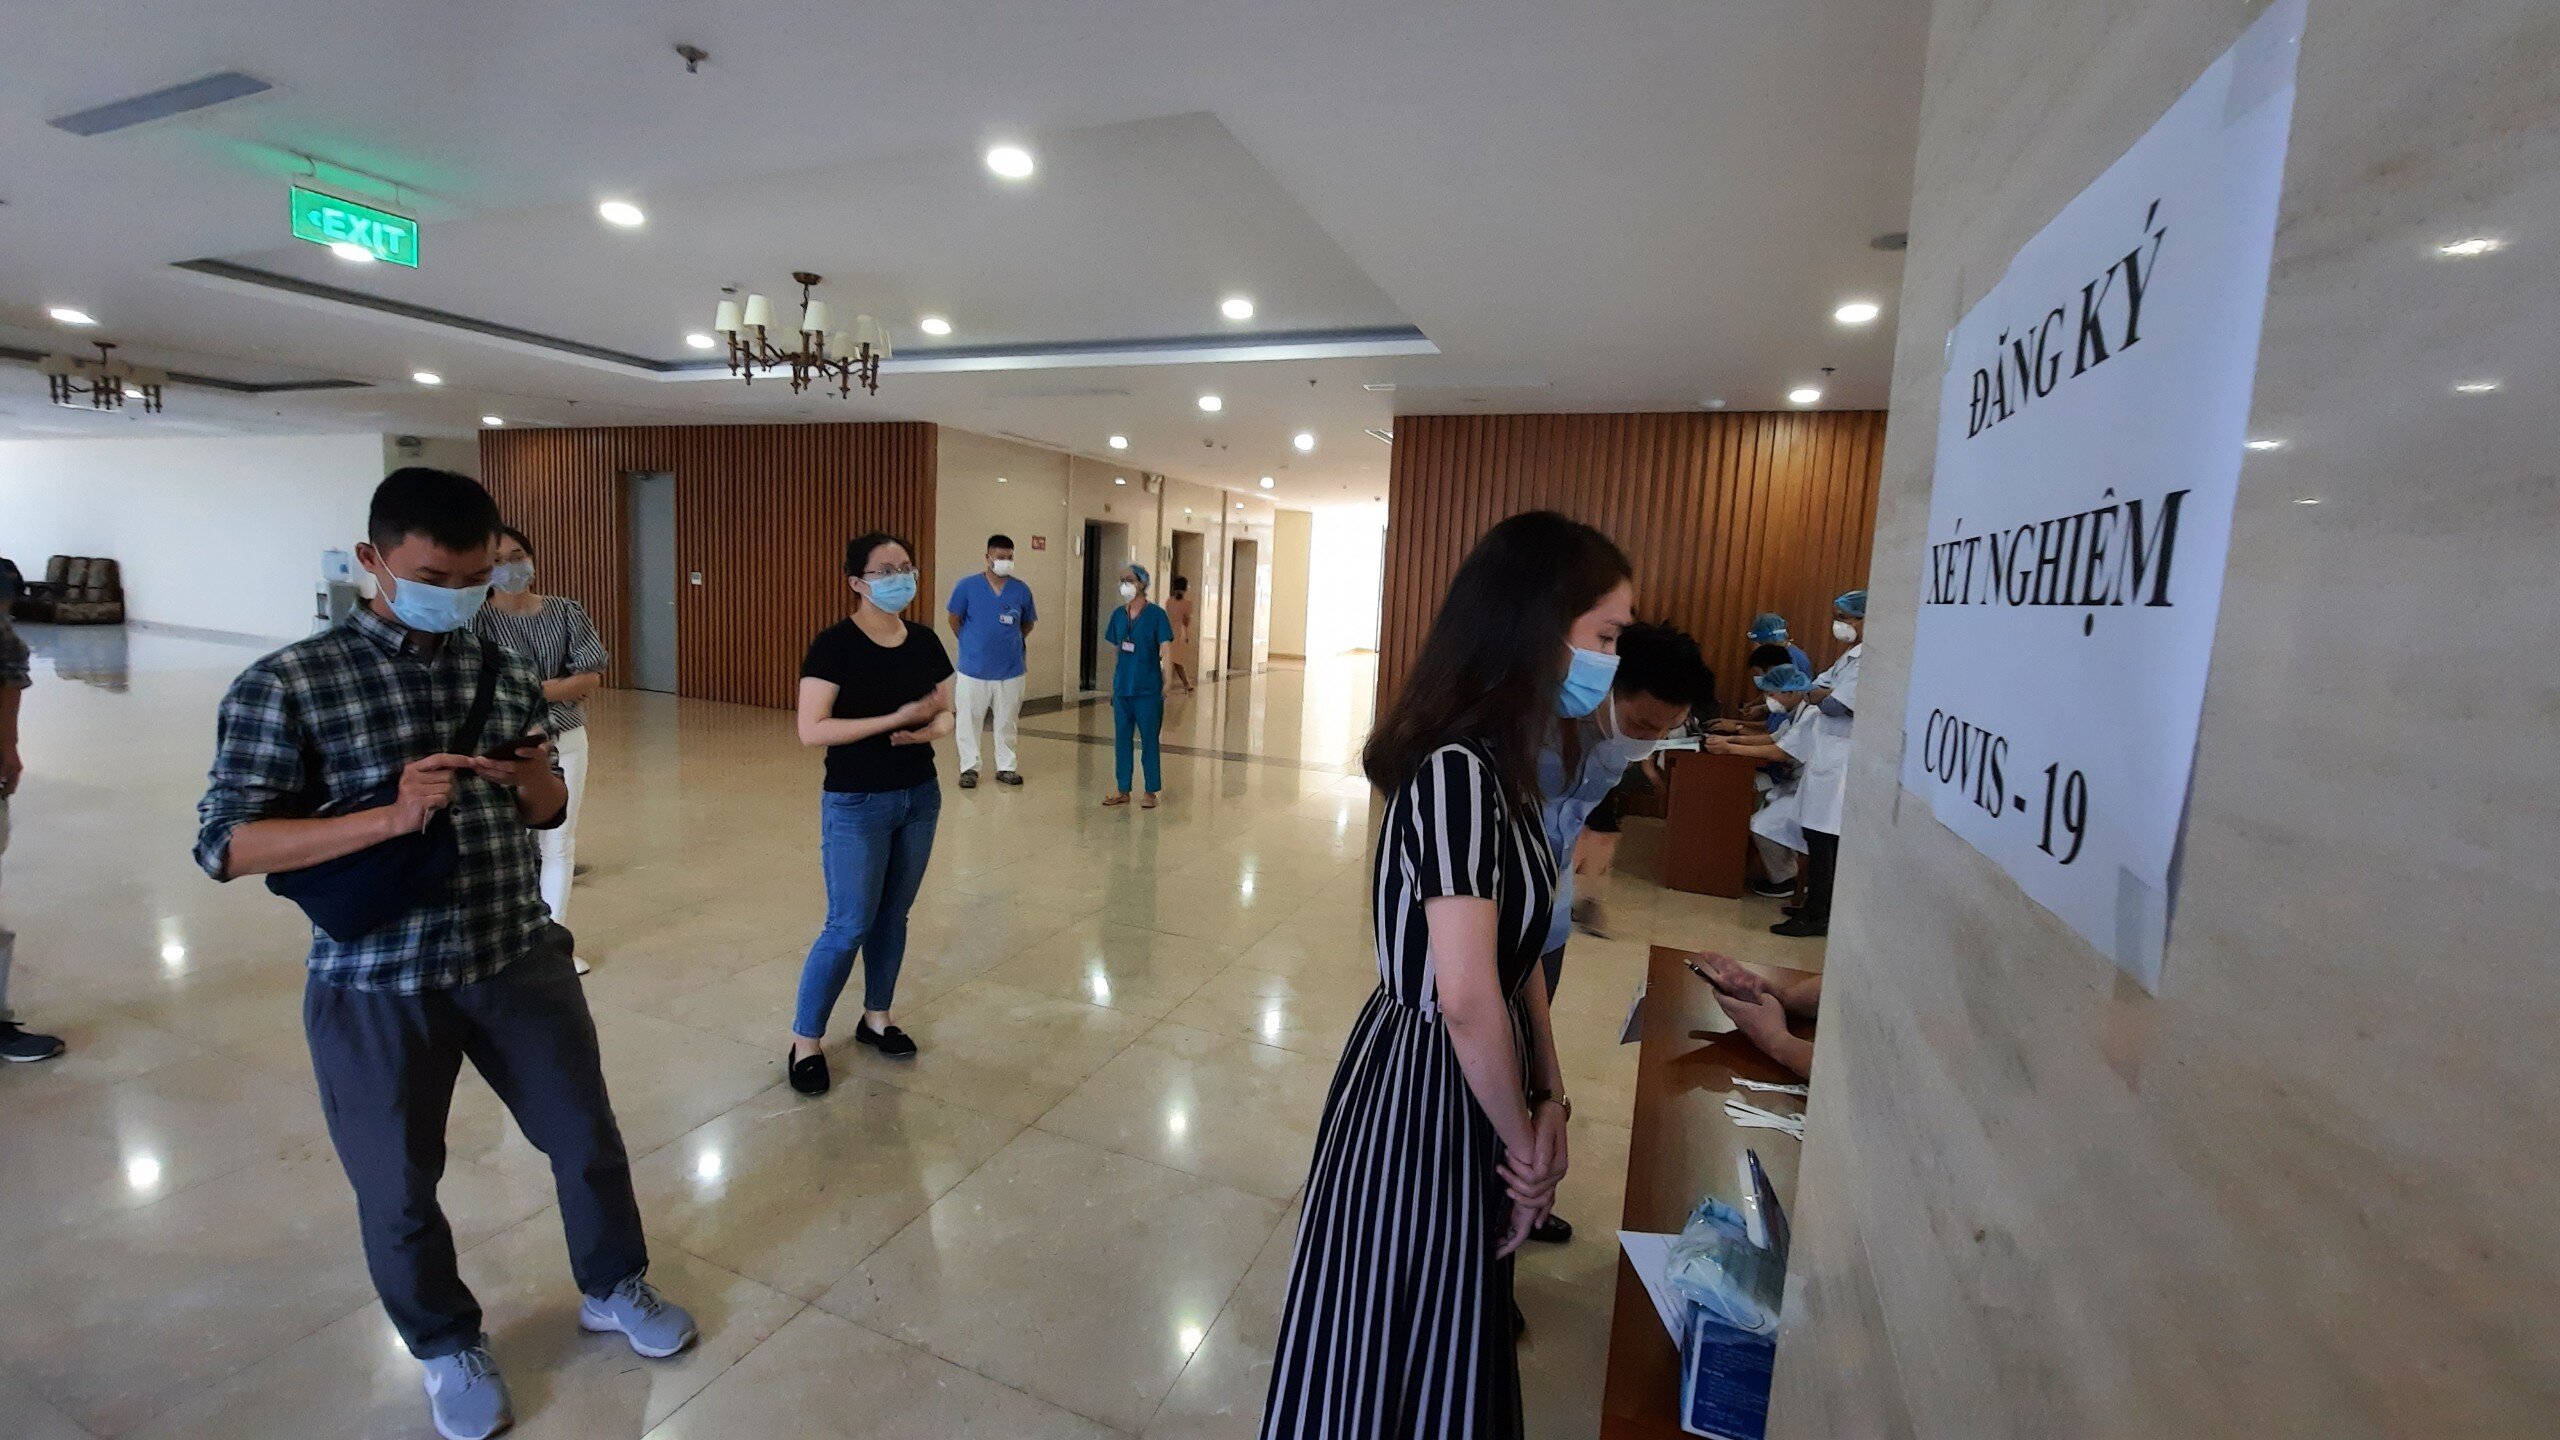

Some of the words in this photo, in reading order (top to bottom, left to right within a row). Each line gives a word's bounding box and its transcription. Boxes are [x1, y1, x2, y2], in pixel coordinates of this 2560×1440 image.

[322, 207, 407, 254] EXIT
[1967, 303, 2065, 439] ĐĂNG
[2071, 198, 2167, 379] KÝ
[1926, 517, 1981, 605] XÉT
[1980, 487, 2191, 637] NGHIỆM
[1924, 708, 2008, 819] COVIS
[2037, 762, 2088, 865] 19
